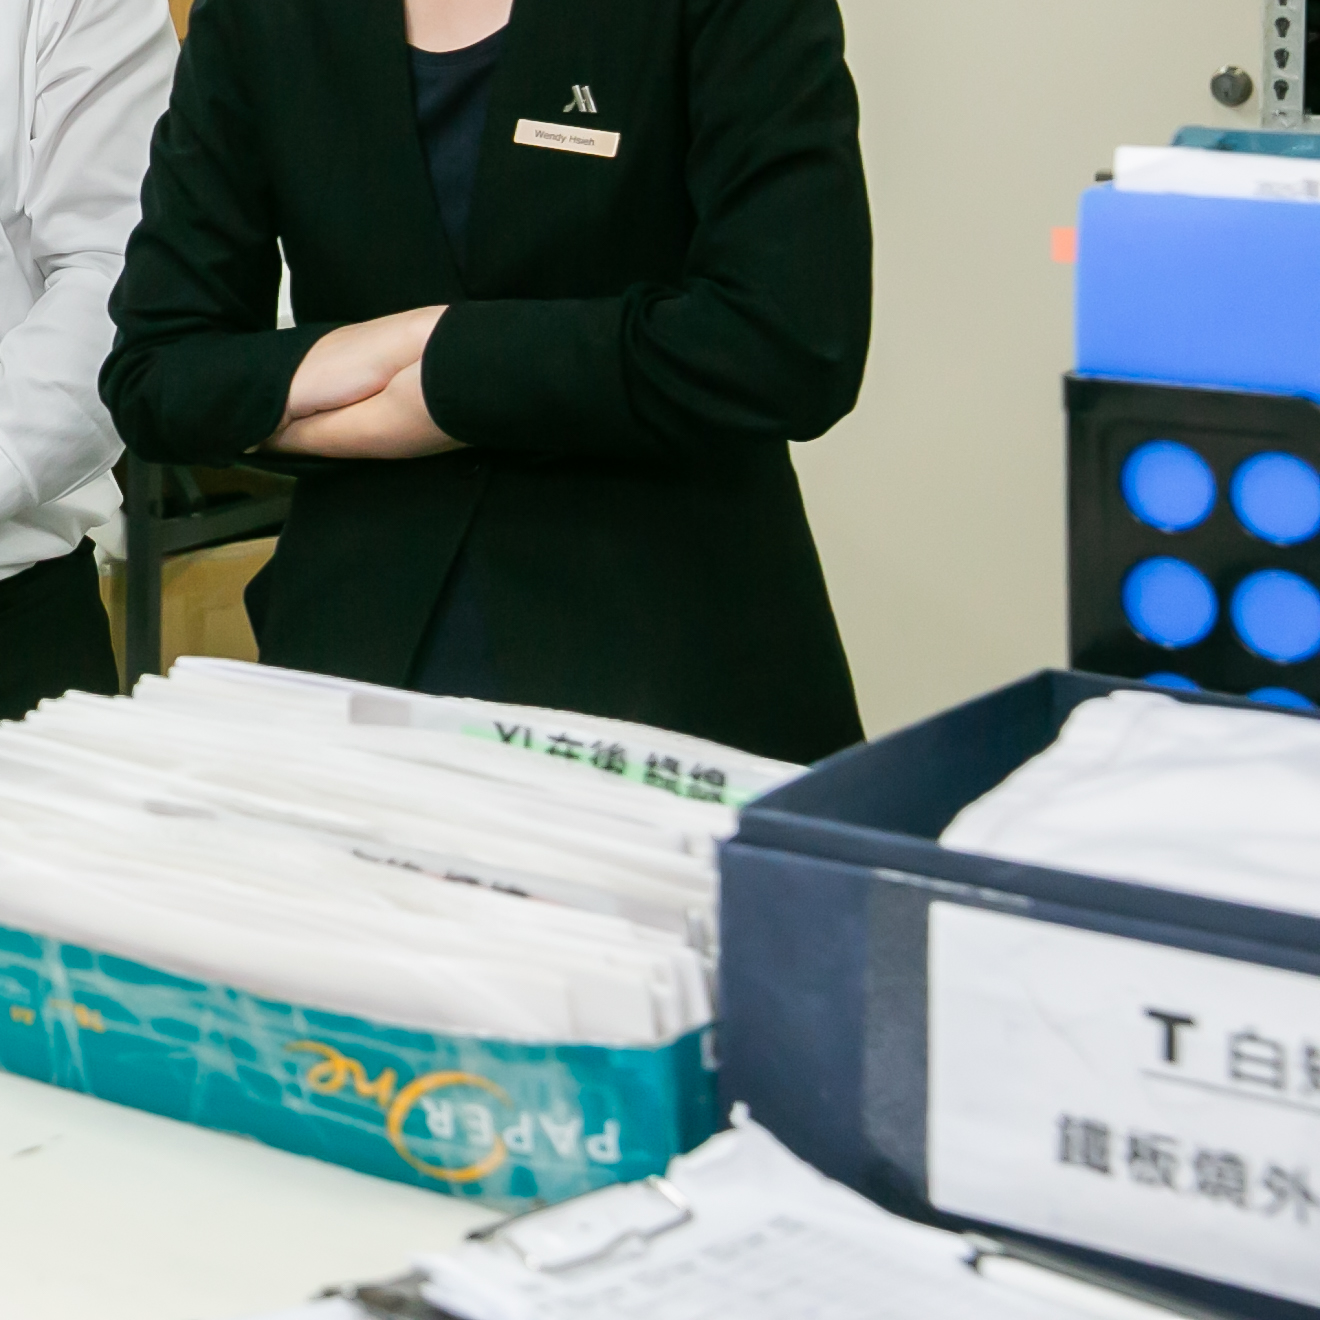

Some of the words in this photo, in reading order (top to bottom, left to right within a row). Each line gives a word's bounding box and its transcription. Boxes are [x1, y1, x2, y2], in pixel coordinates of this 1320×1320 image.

[534, 129, 567, 144] Wendy
[1142, 1007, 1196, 1064] T
[420, 1095, 623, 1164] PAPER
